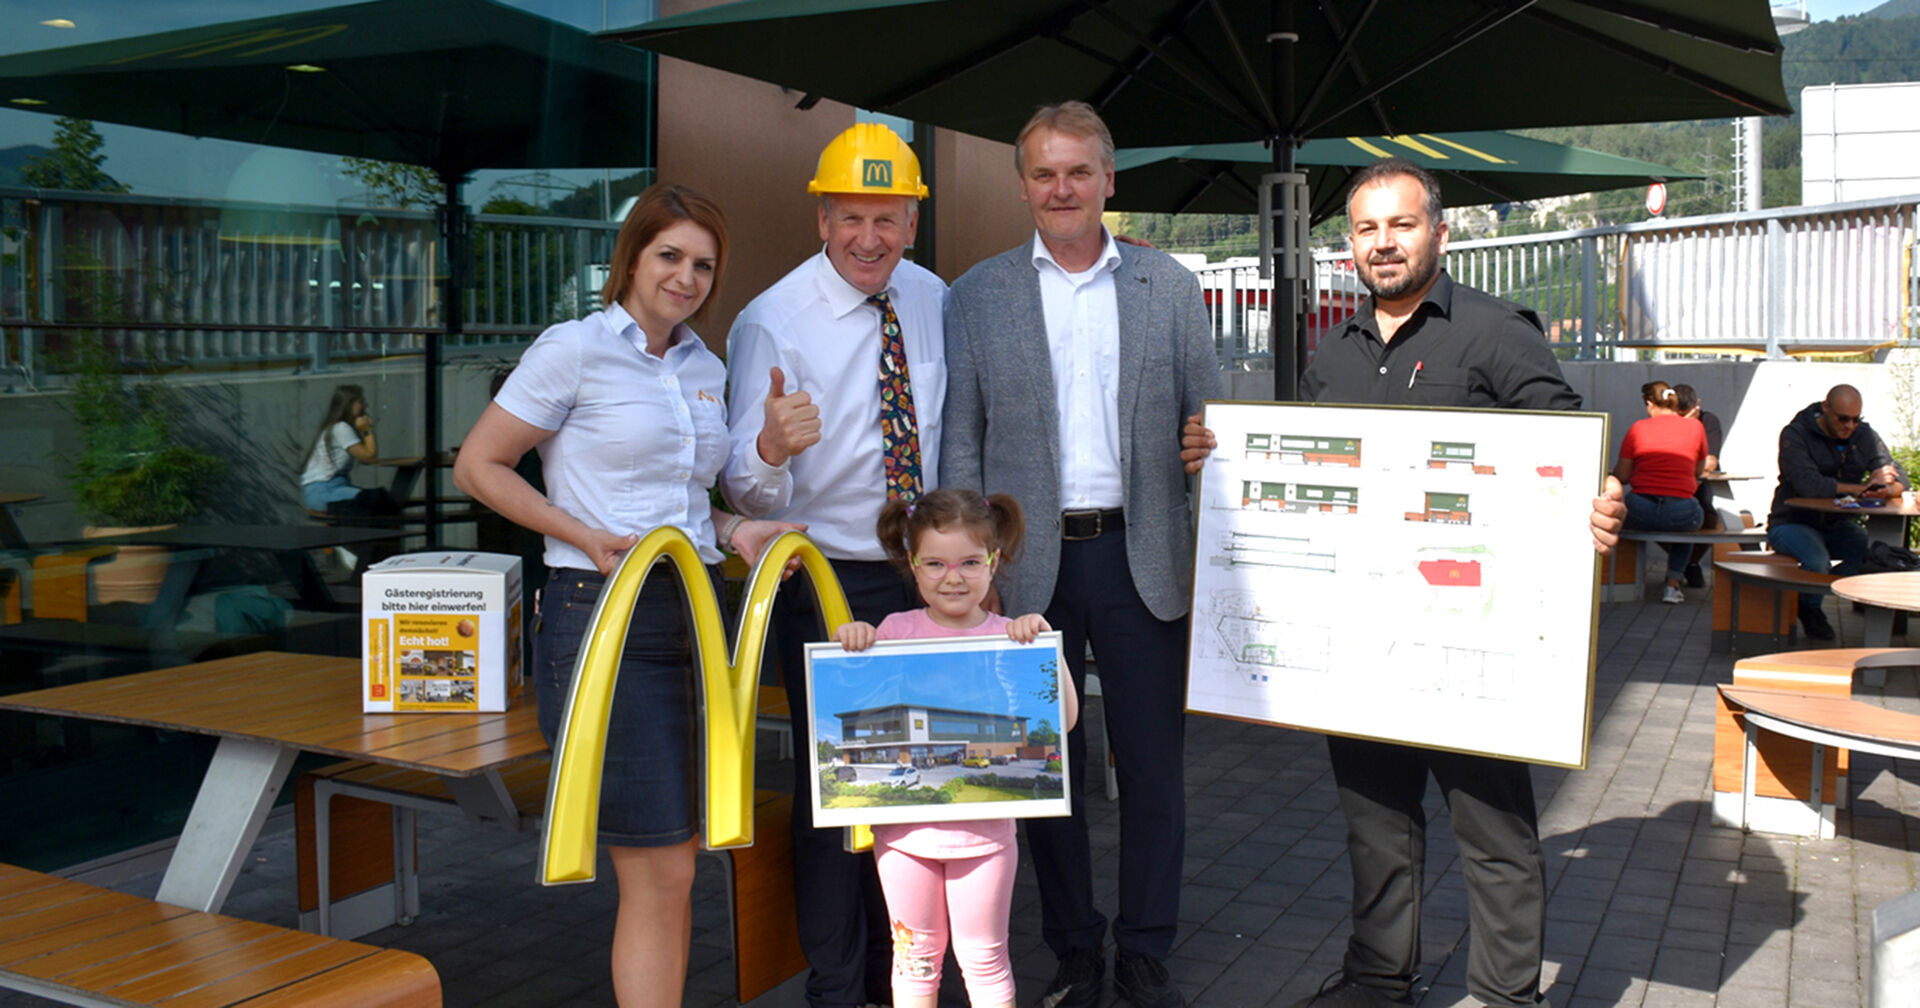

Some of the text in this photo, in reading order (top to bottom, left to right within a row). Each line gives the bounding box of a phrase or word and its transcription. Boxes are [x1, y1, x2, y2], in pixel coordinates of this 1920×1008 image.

[384, 588, 484, 600] Gästeregistrierung
[381, 602, 487, 611] bitte hier einwerfen!
[399, 636, 449, 647] Echt hot!
